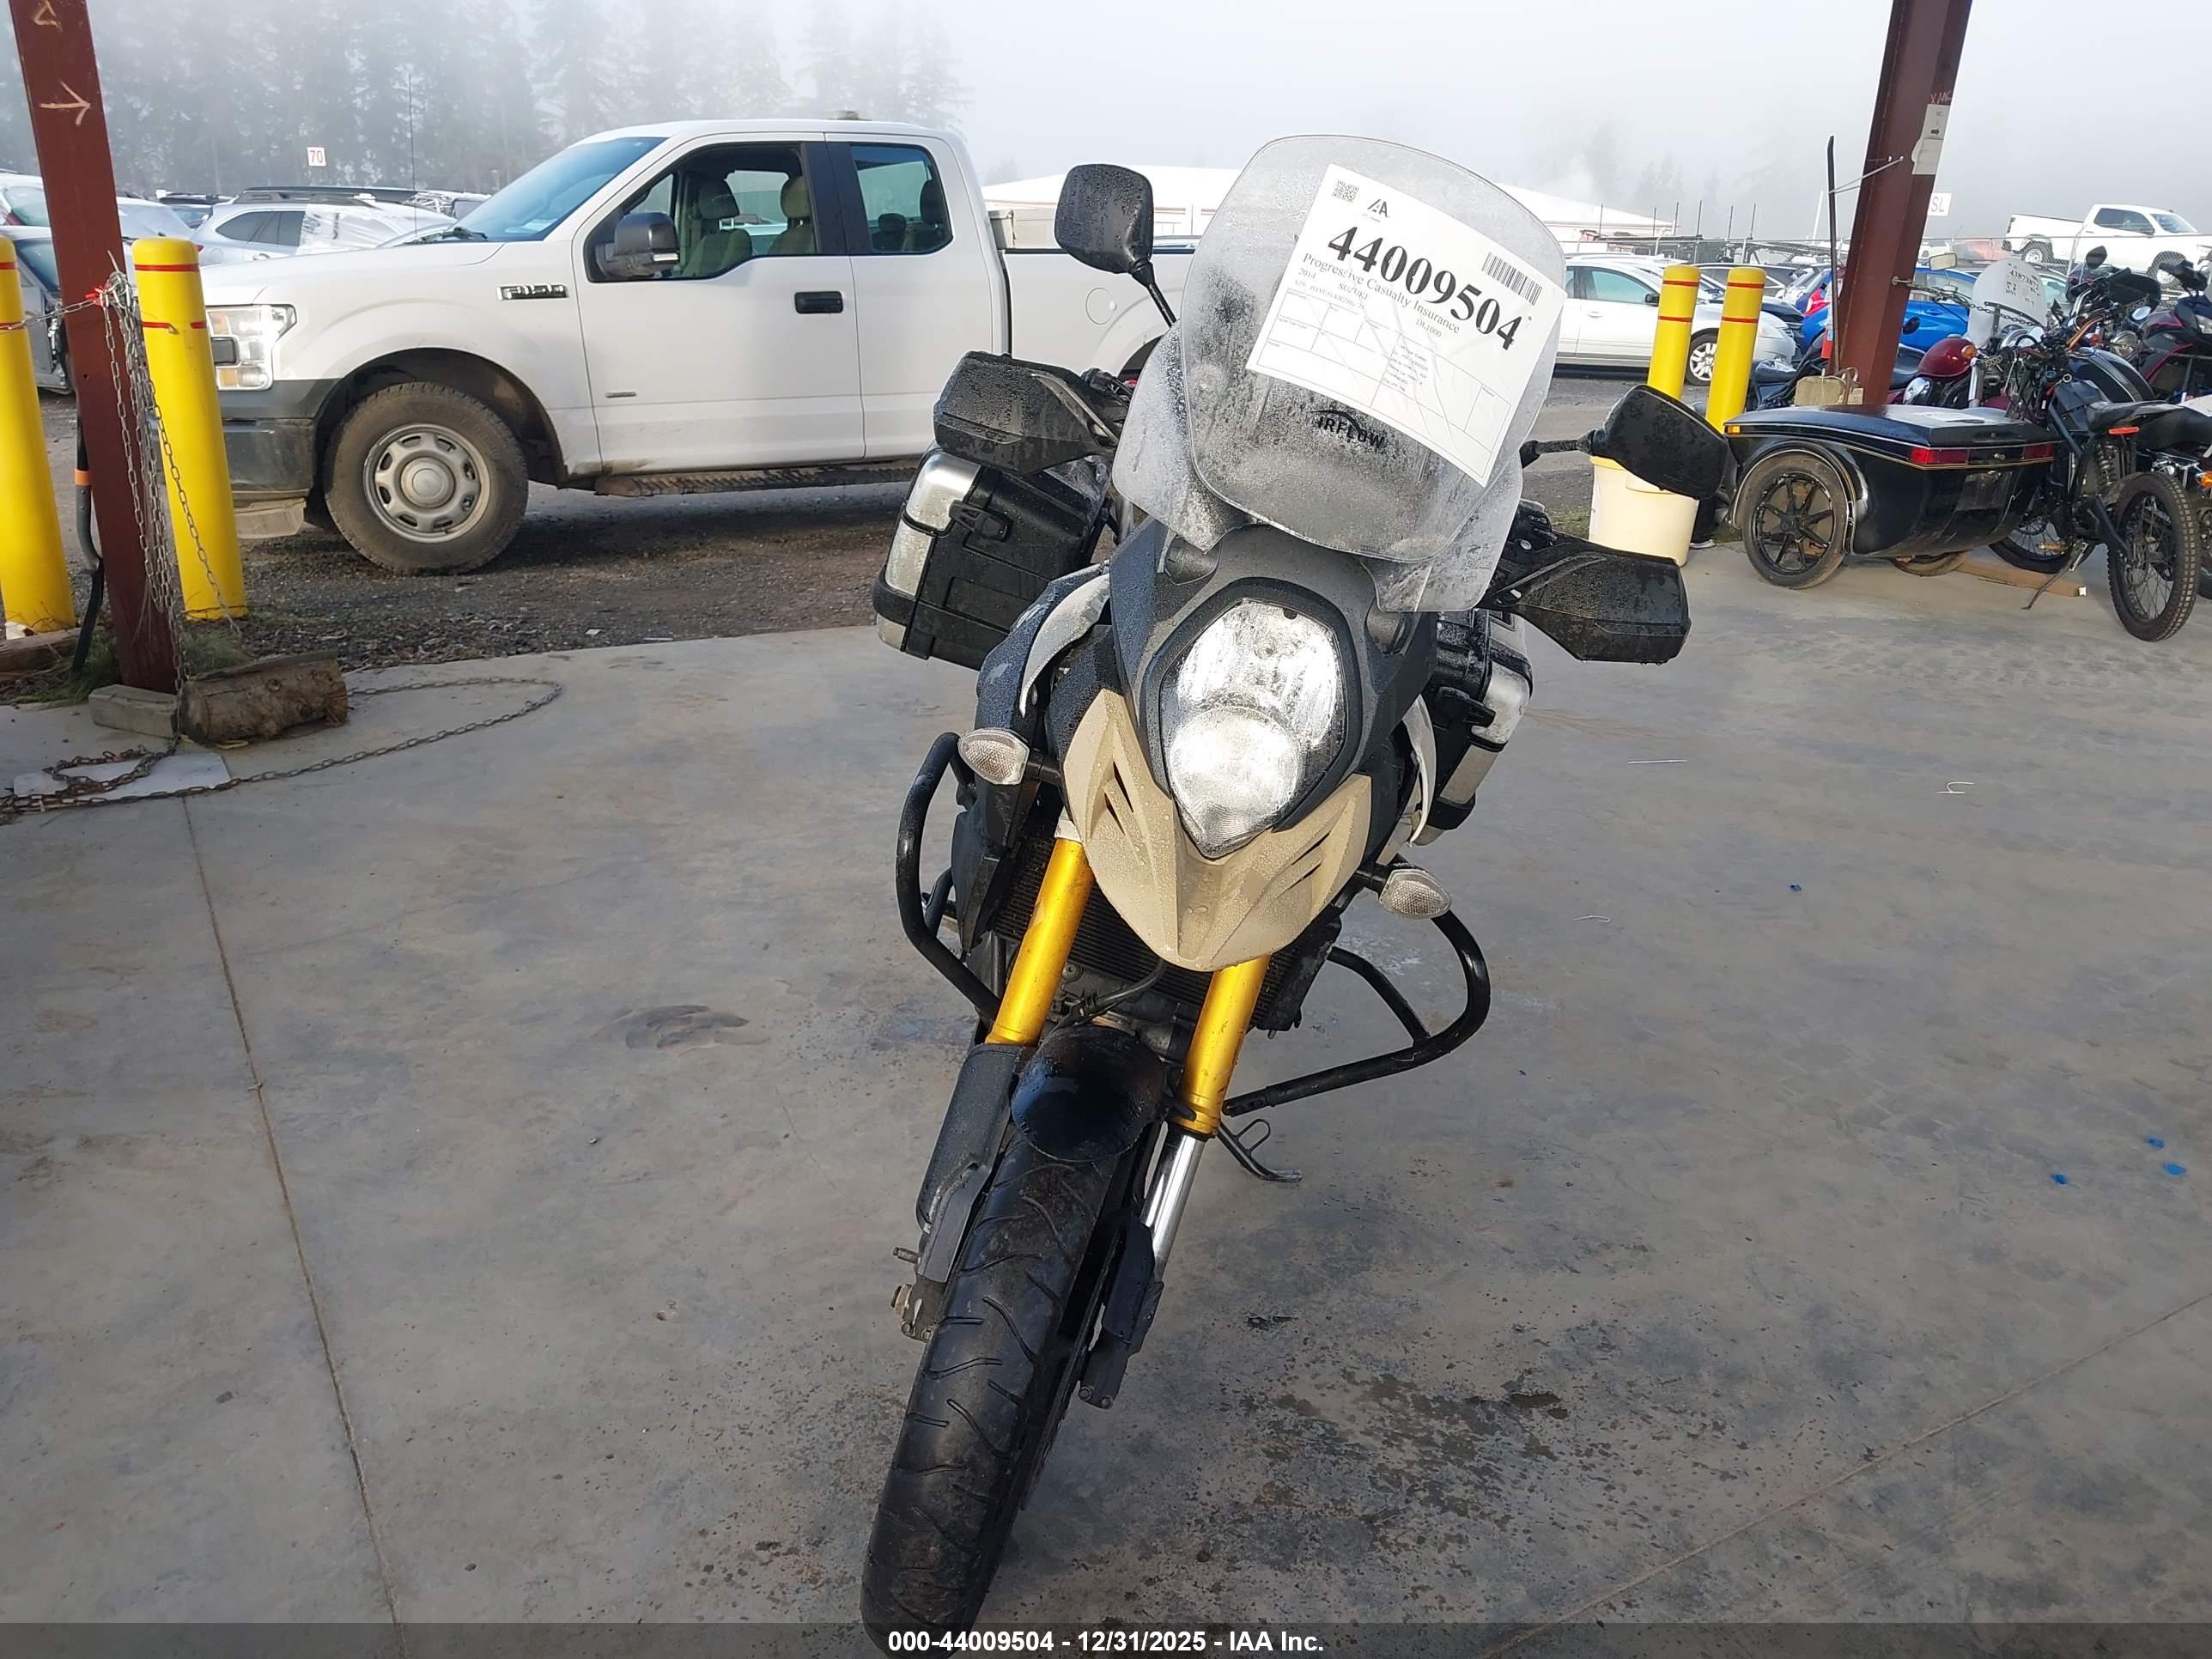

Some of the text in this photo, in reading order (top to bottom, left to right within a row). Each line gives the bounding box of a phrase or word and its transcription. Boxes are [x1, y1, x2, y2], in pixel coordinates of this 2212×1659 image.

[309, 150, 324, 164] 70
[1931, 196, 1945, 213] SL
[1298, 268, 1316, 279] 2014
[1338, 283, 1369, 301] SUZUKI
[1415, 319, 1442, 337] DL1000
[1303, 253, 1364, 284] Progressive
[1367, 278, 1412, 309] Casualty
[1413, 300, 1461, 334] Insurance
[1328, 226, 1523, 351] 44009504
